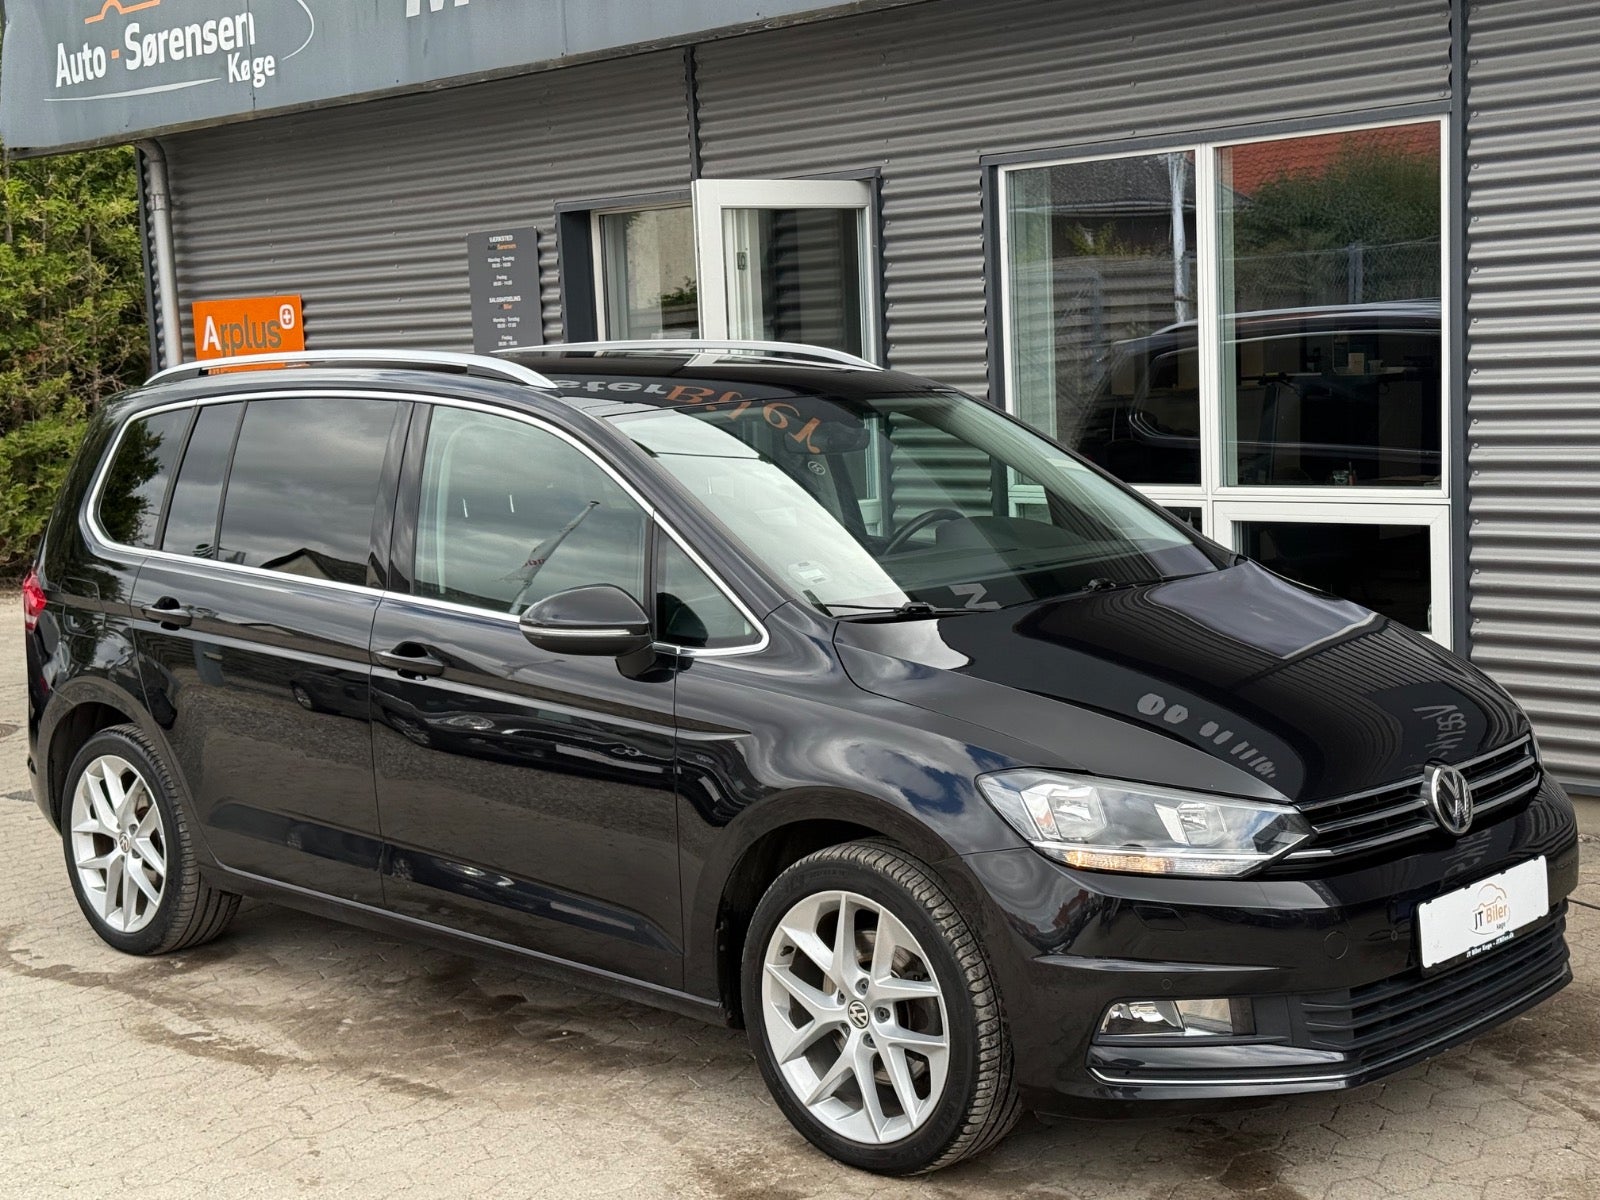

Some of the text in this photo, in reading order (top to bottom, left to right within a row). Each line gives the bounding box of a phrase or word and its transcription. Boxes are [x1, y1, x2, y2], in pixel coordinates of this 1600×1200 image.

[56, 11, 255, 88] Auto Sørensen
[227, 52, 275, 88] Køge
[1486, 904, 1507, 924] Biler
